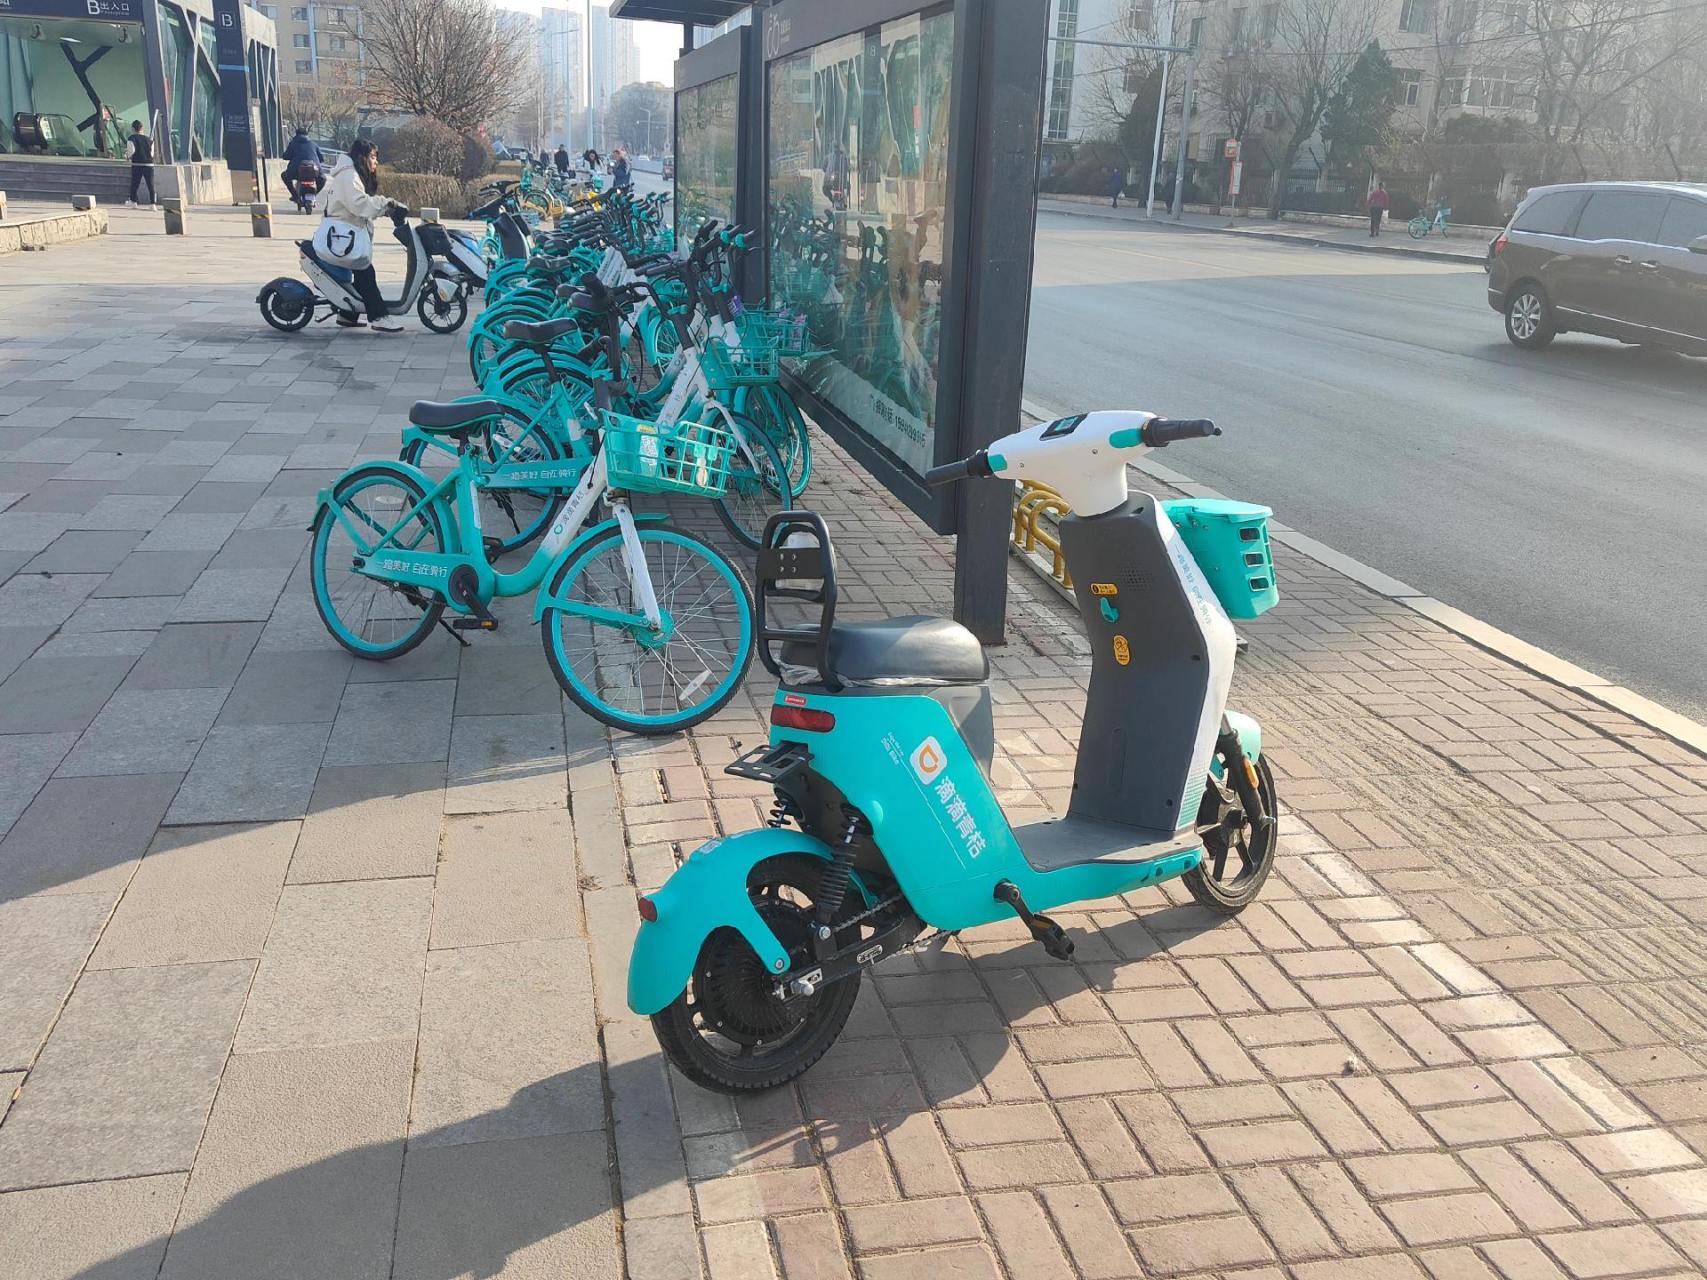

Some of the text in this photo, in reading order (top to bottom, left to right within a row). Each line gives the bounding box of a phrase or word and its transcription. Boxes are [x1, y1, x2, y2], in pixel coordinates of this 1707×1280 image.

[100, 2, 130, 11] 出入口
[221, 14, 233, 27] B
[934, 775, 987, 859] 滴滴青桔
